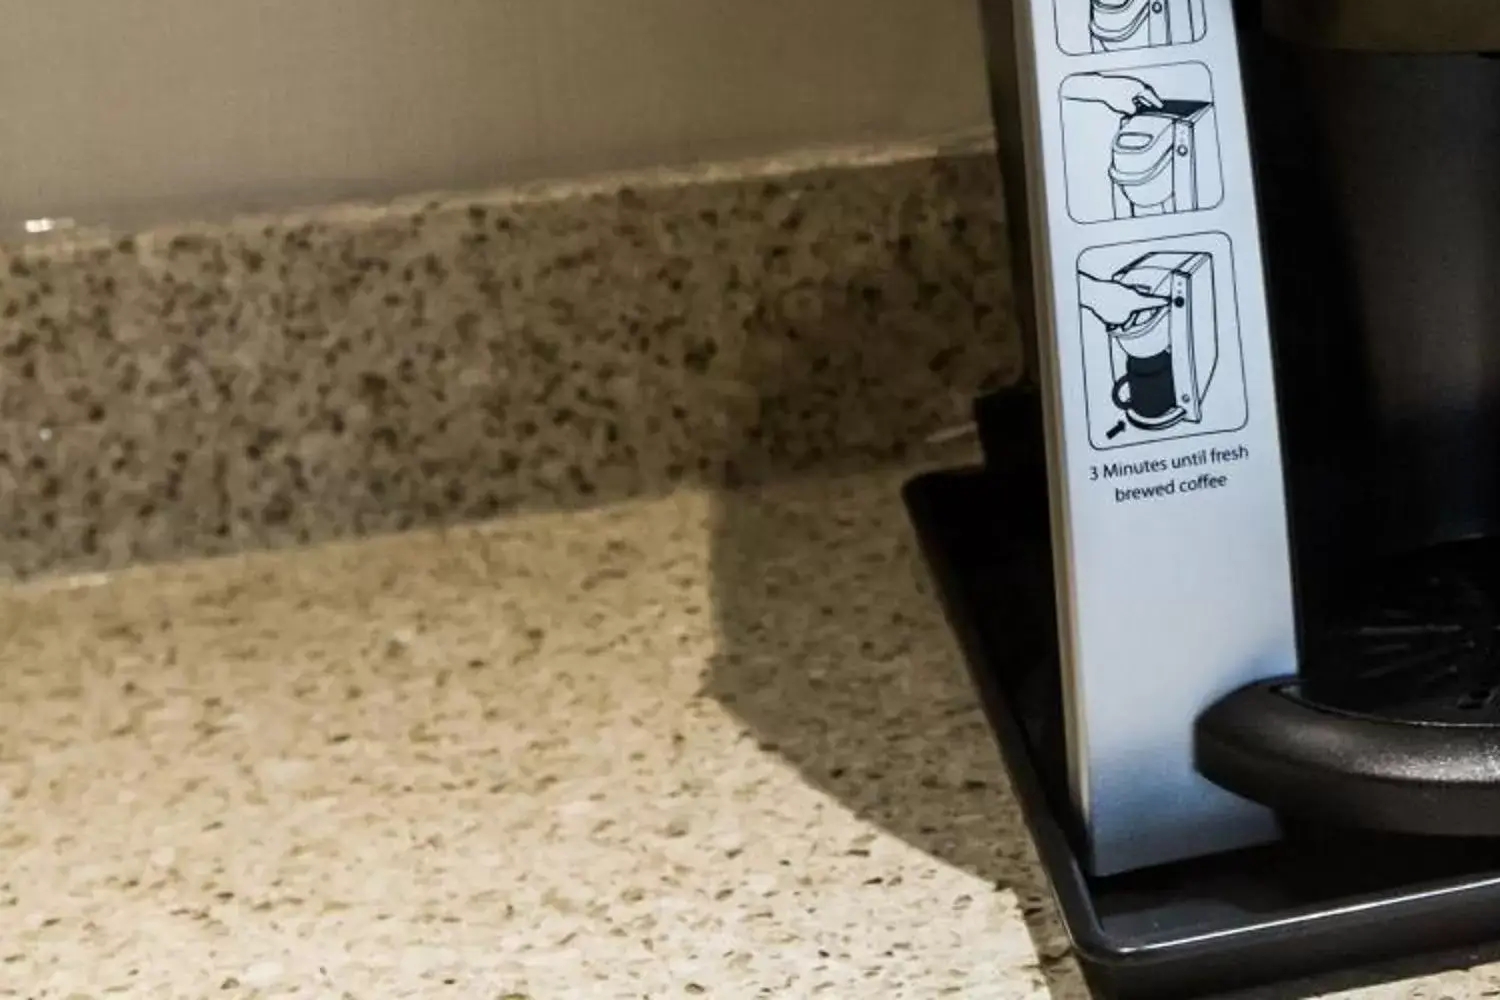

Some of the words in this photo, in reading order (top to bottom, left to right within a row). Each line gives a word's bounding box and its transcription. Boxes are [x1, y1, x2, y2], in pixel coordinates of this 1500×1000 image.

[1089, 466, 1099, 481] 3
[1103, 459, 1168, 480] Minutes
[1171, 449, 1207, 470] until
[1210, 445, 1249, 465] fresh
[1115, 479, 1175, 503] brewed
[1179, 473, 1228, 493] coffee
